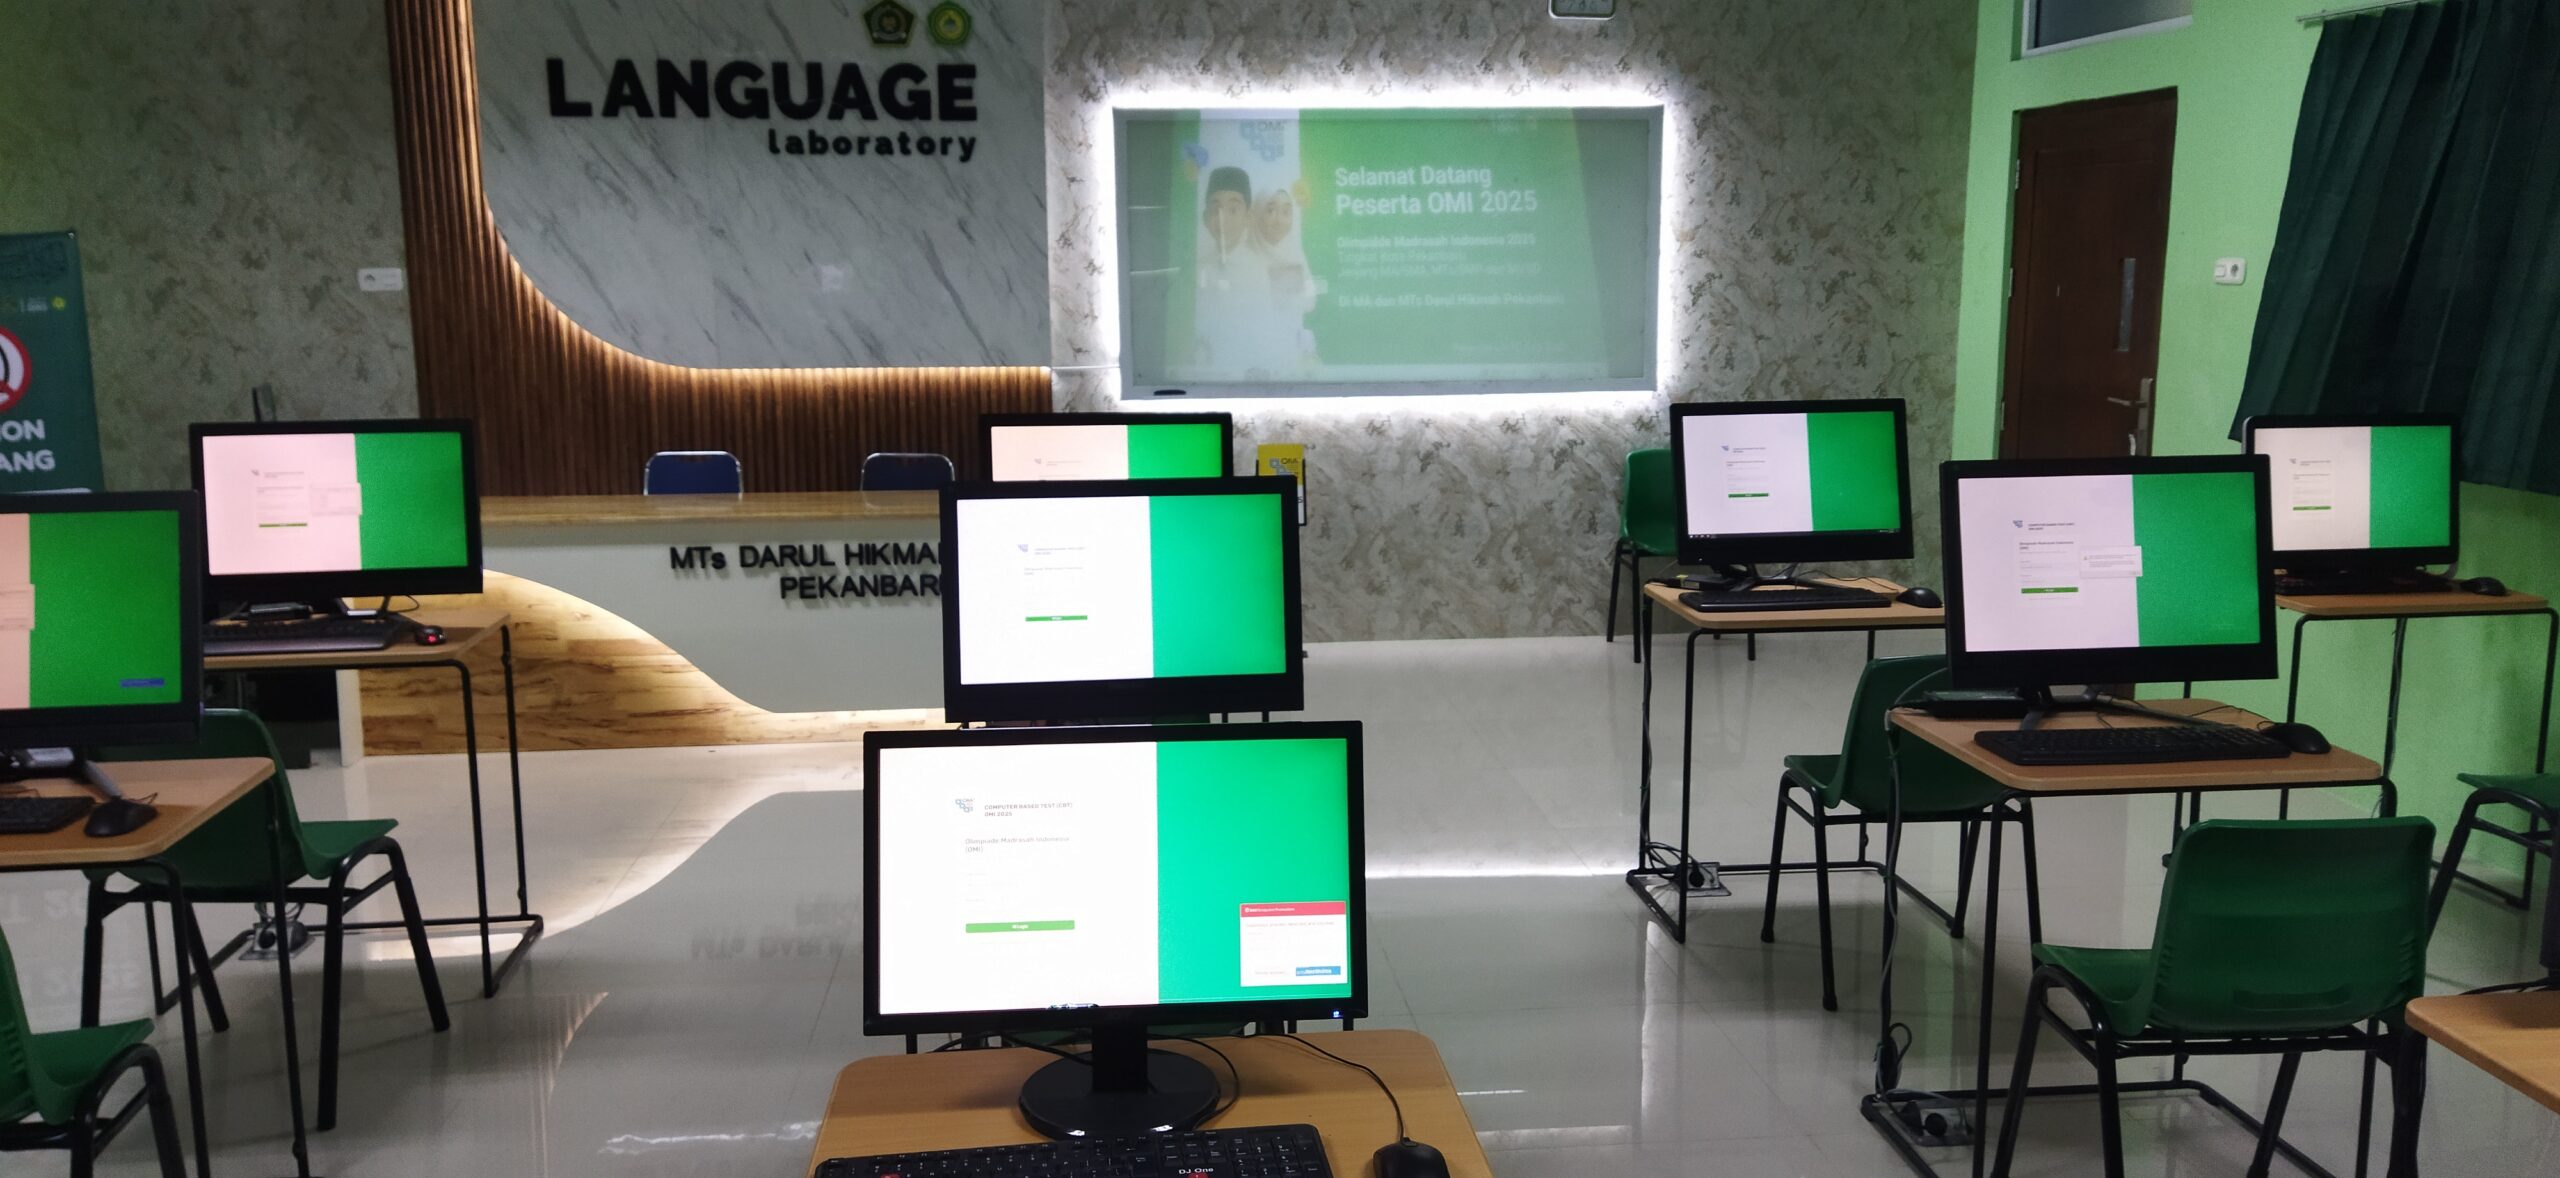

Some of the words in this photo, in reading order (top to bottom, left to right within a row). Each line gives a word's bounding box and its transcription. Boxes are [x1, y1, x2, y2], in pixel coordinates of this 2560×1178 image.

[546, 58, 978, 121] LANGUAGE
[768, 128, 978, 163] laboratory
[1335, 166, 1415, 187] Selamat
[1421, 165, 1493, 188] Datang
[1337, 193, 1422, 215] Peserta
[1428, 191, 1474, 214] OMI
[1481, 189, 1539, 212] 2025
[670, 546, 726, 569] MTs
[739, 543, 836, 568] DARUL
[844, 542, 941, 566] HIKMA
[780, 574, 941, 599] PEKANBAR
